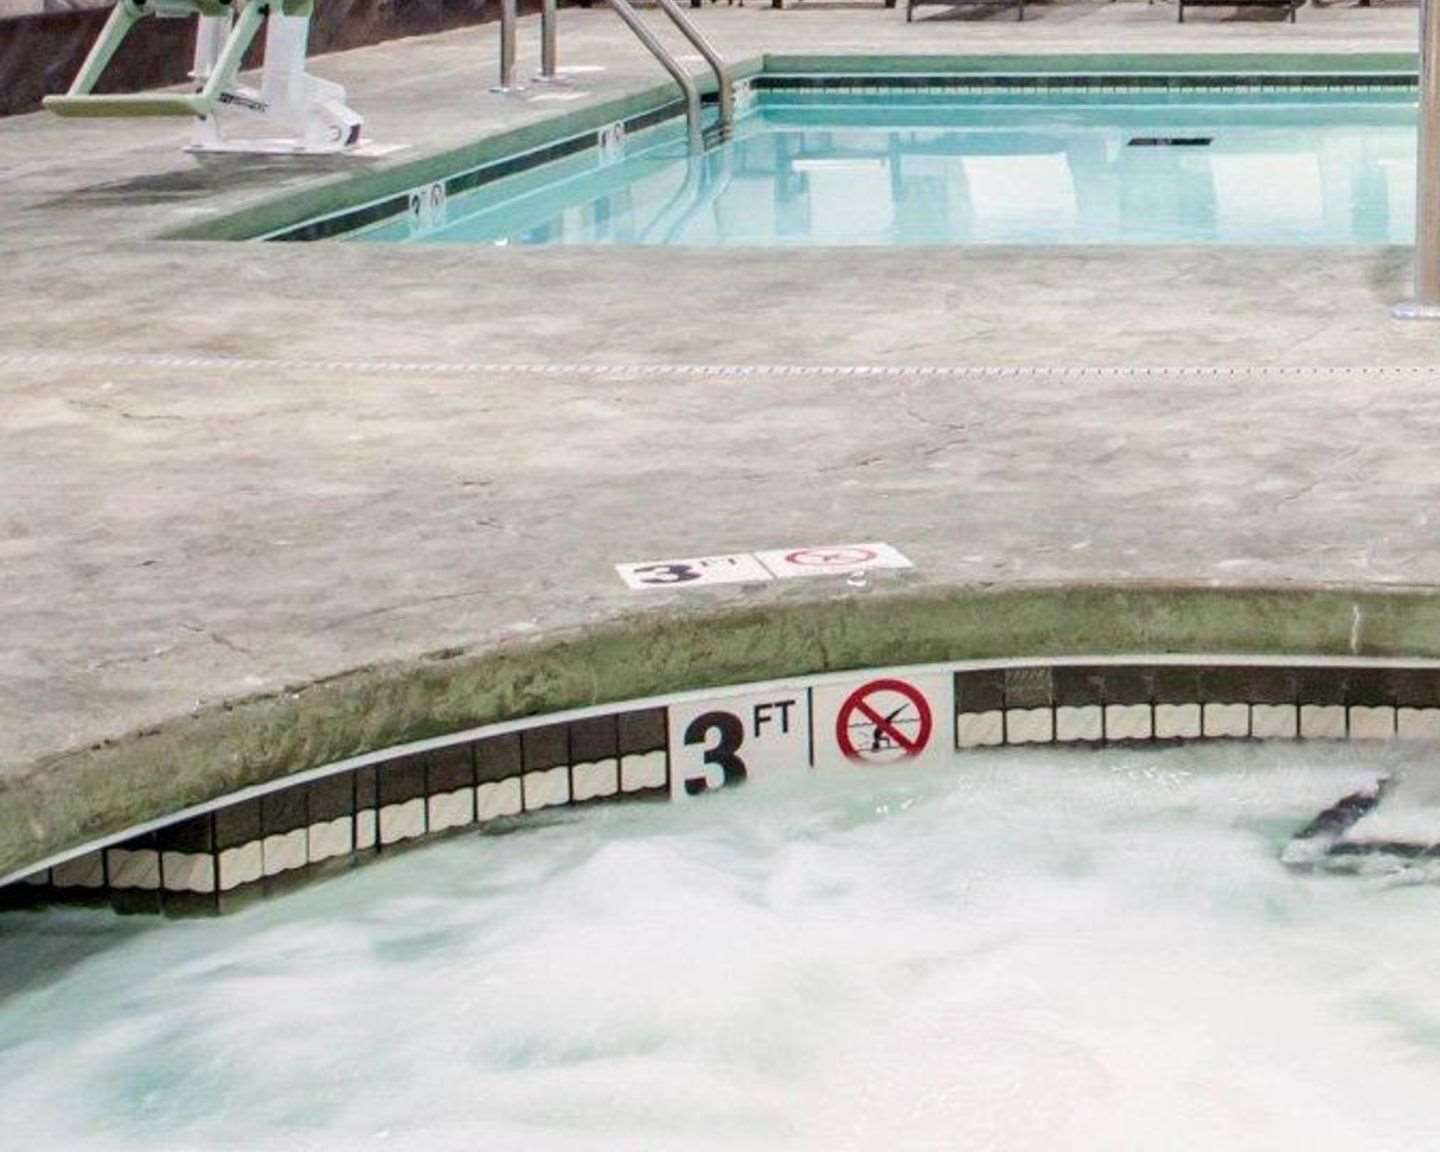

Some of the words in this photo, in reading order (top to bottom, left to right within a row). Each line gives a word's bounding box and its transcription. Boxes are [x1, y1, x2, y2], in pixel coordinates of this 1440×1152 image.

[633, 564, 701, 584] 3
[684, 710, 747, 796] 3
[753, 699, 796, 738] FT
